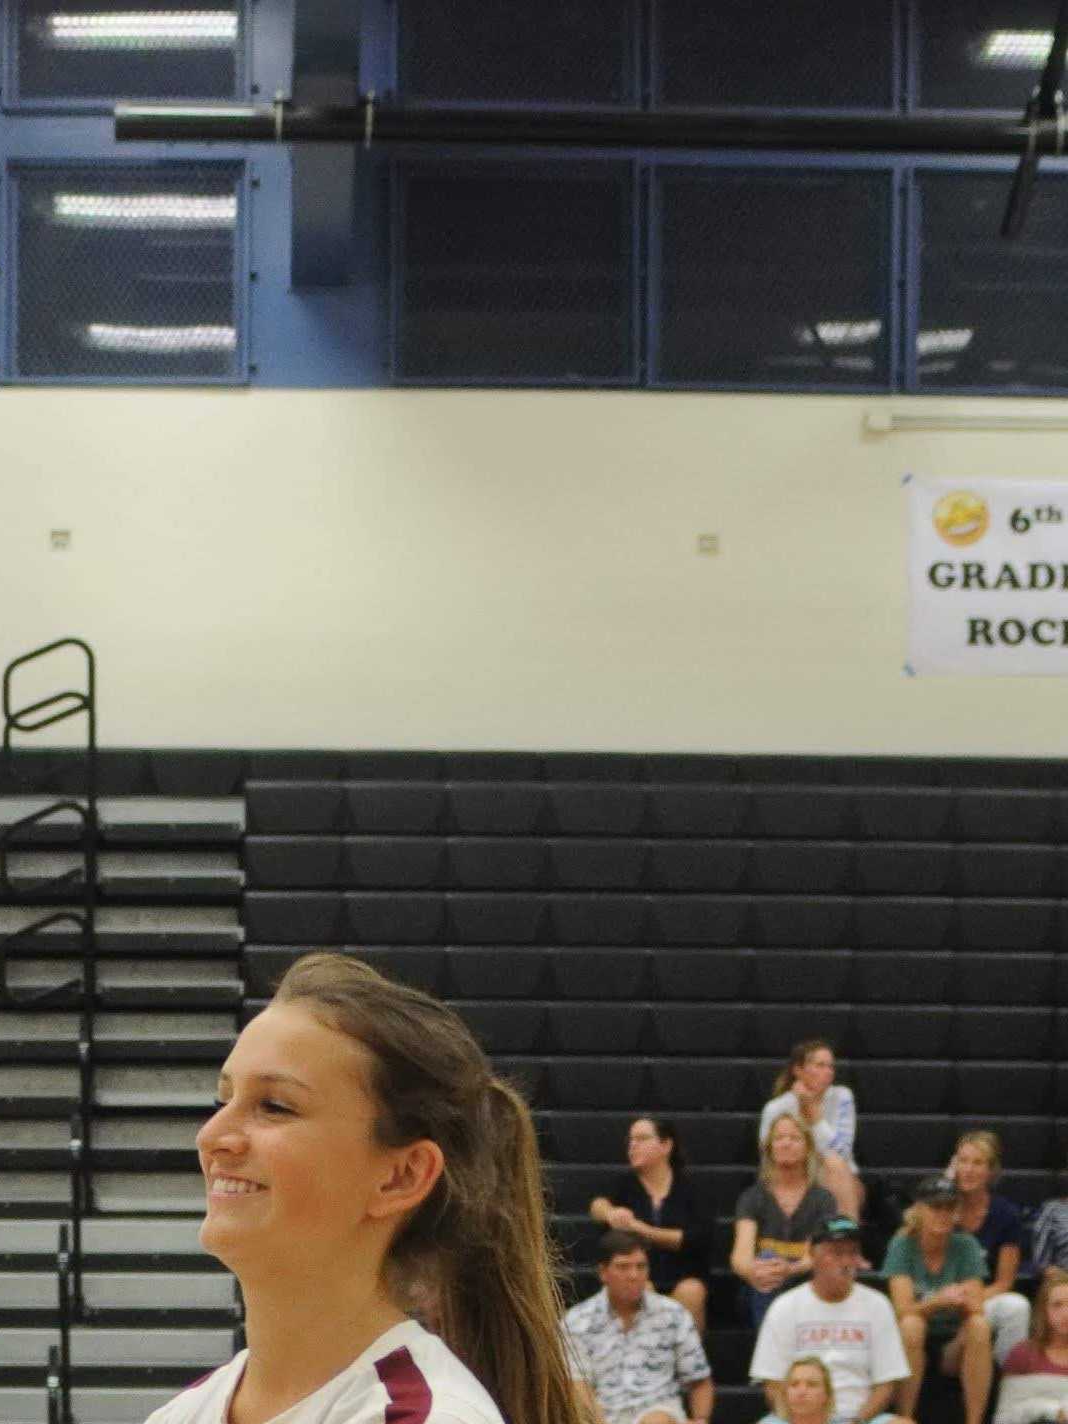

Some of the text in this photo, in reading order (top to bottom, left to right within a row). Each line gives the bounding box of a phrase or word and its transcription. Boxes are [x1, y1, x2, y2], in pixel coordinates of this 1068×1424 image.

[1010, 505, 1062, 533] 6th
[928, 561, 1068, 589] GRAD
[967, 618, 1068, 646] ROC
